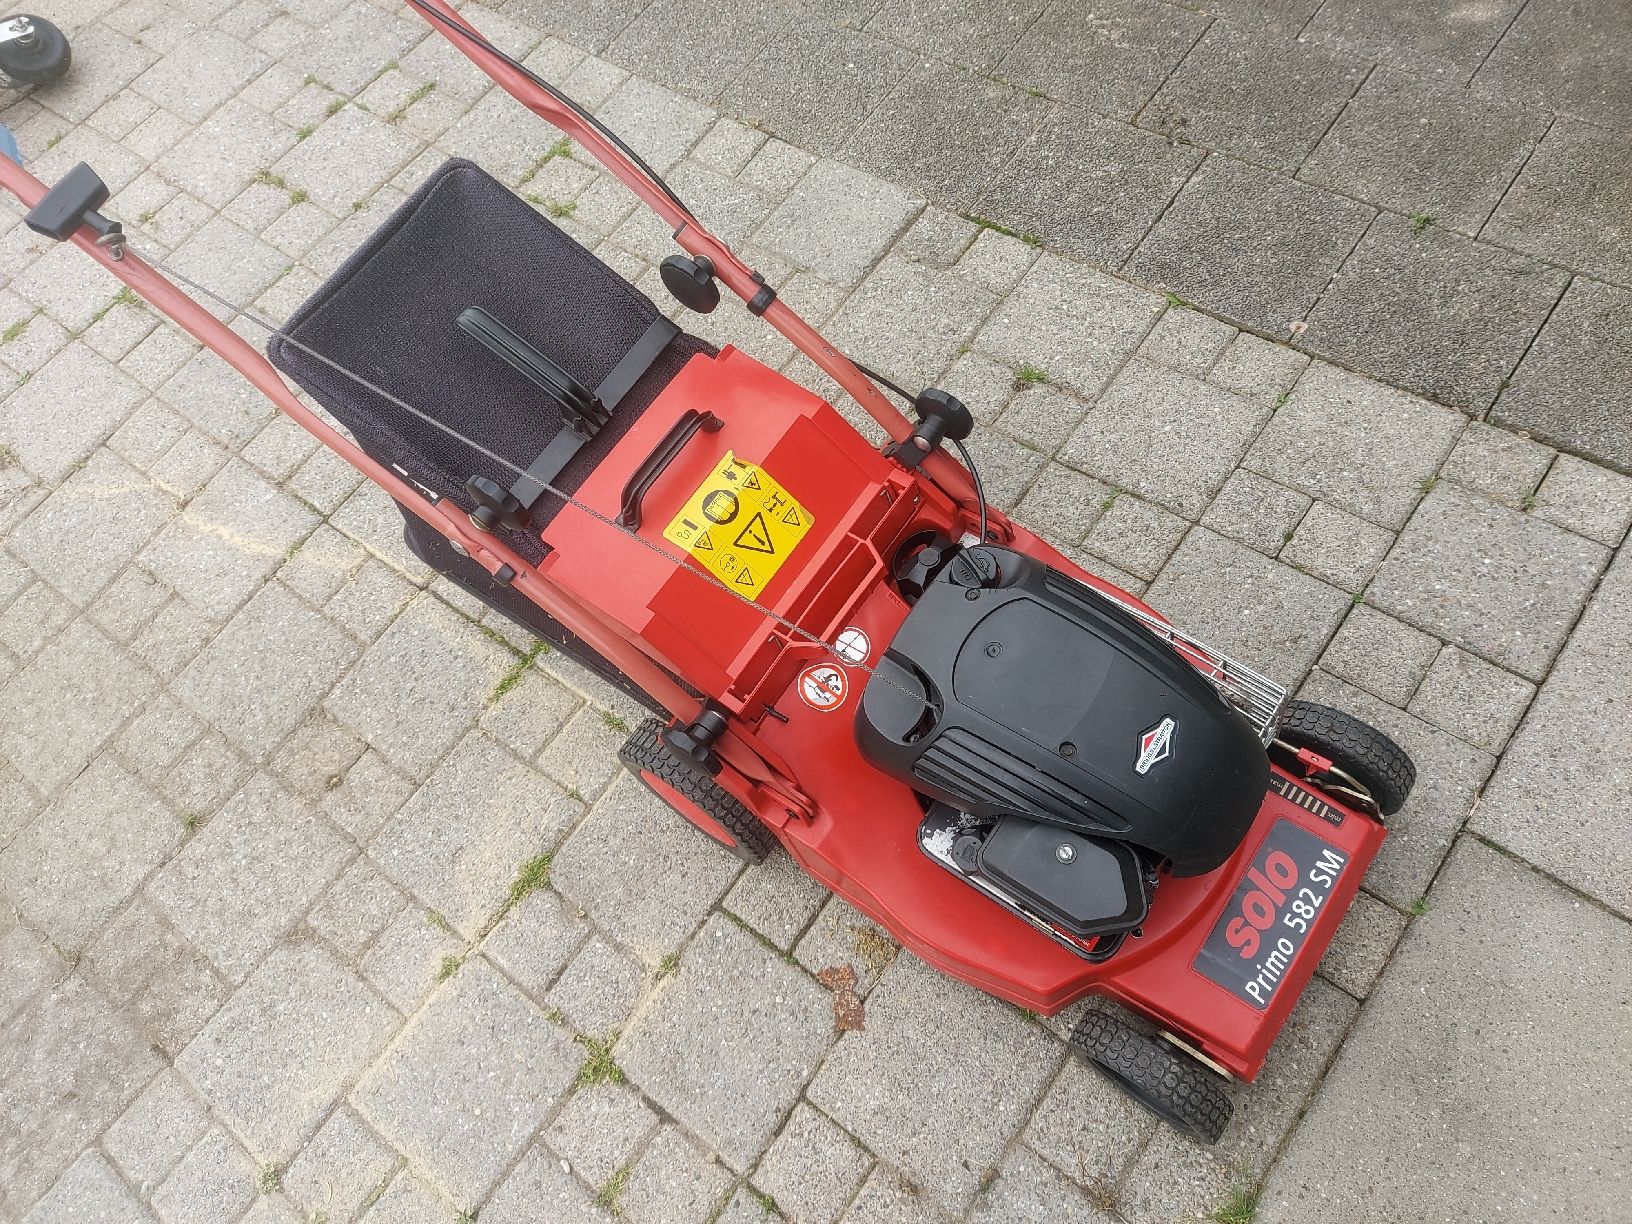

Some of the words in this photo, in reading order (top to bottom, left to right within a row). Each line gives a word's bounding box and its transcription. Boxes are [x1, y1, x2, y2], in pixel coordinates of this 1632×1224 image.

[1225, 850, 1299, 959] solo
[1244, 937, 1294, 1005] Primo
[1283, 887, 1323, 934] 582
[1309, 848, 1345, 889] SM
